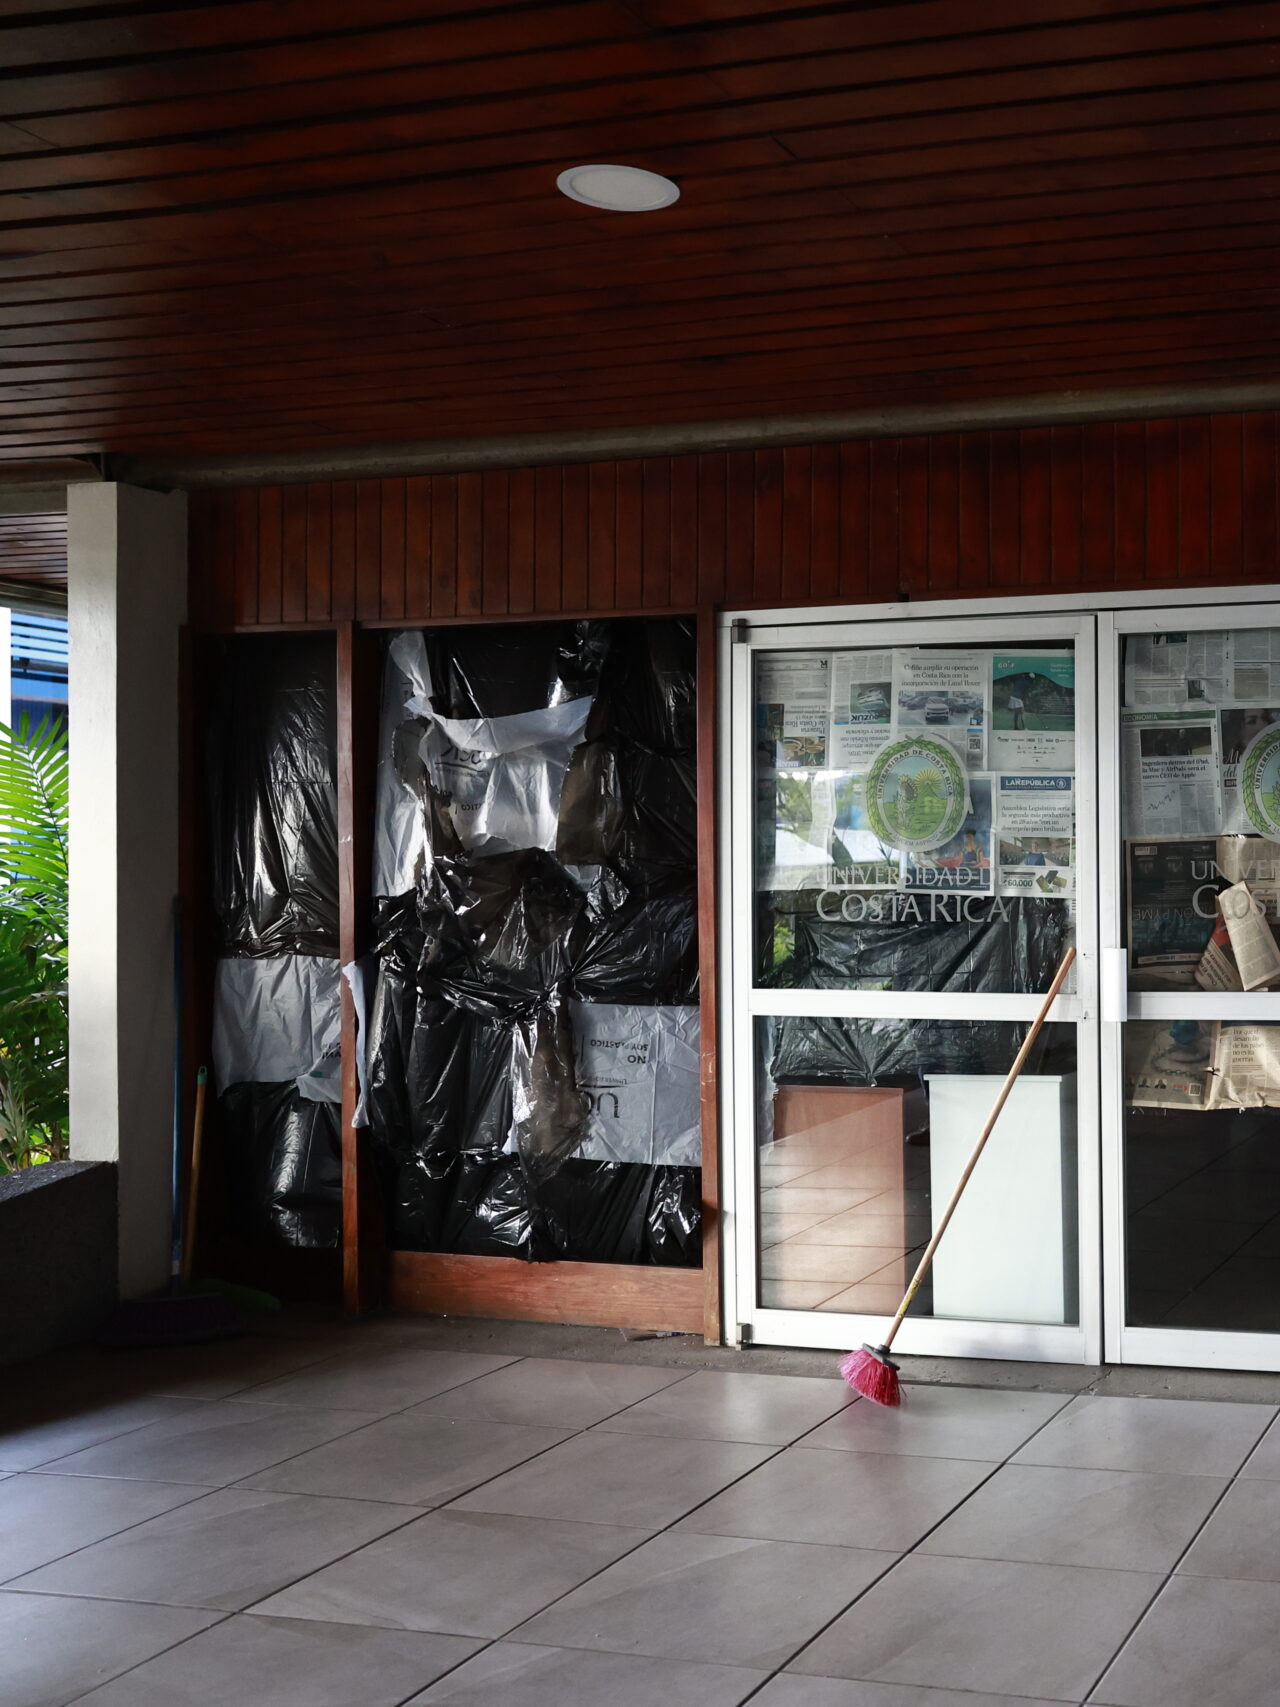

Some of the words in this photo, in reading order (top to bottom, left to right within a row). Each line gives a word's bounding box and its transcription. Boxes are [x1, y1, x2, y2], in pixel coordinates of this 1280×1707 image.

[878, 752, 910, 800] UNIVERSIDAD
[925, 751, 947, 774] COSTA
[945, 775, 953, 796] RICA
[816, 889, 923, 922] COSTA
[930, 893, 1010, 922] RICA
[632, 1044, 649, 1052] SOY
[627, 1055, 647, 1064] NO
